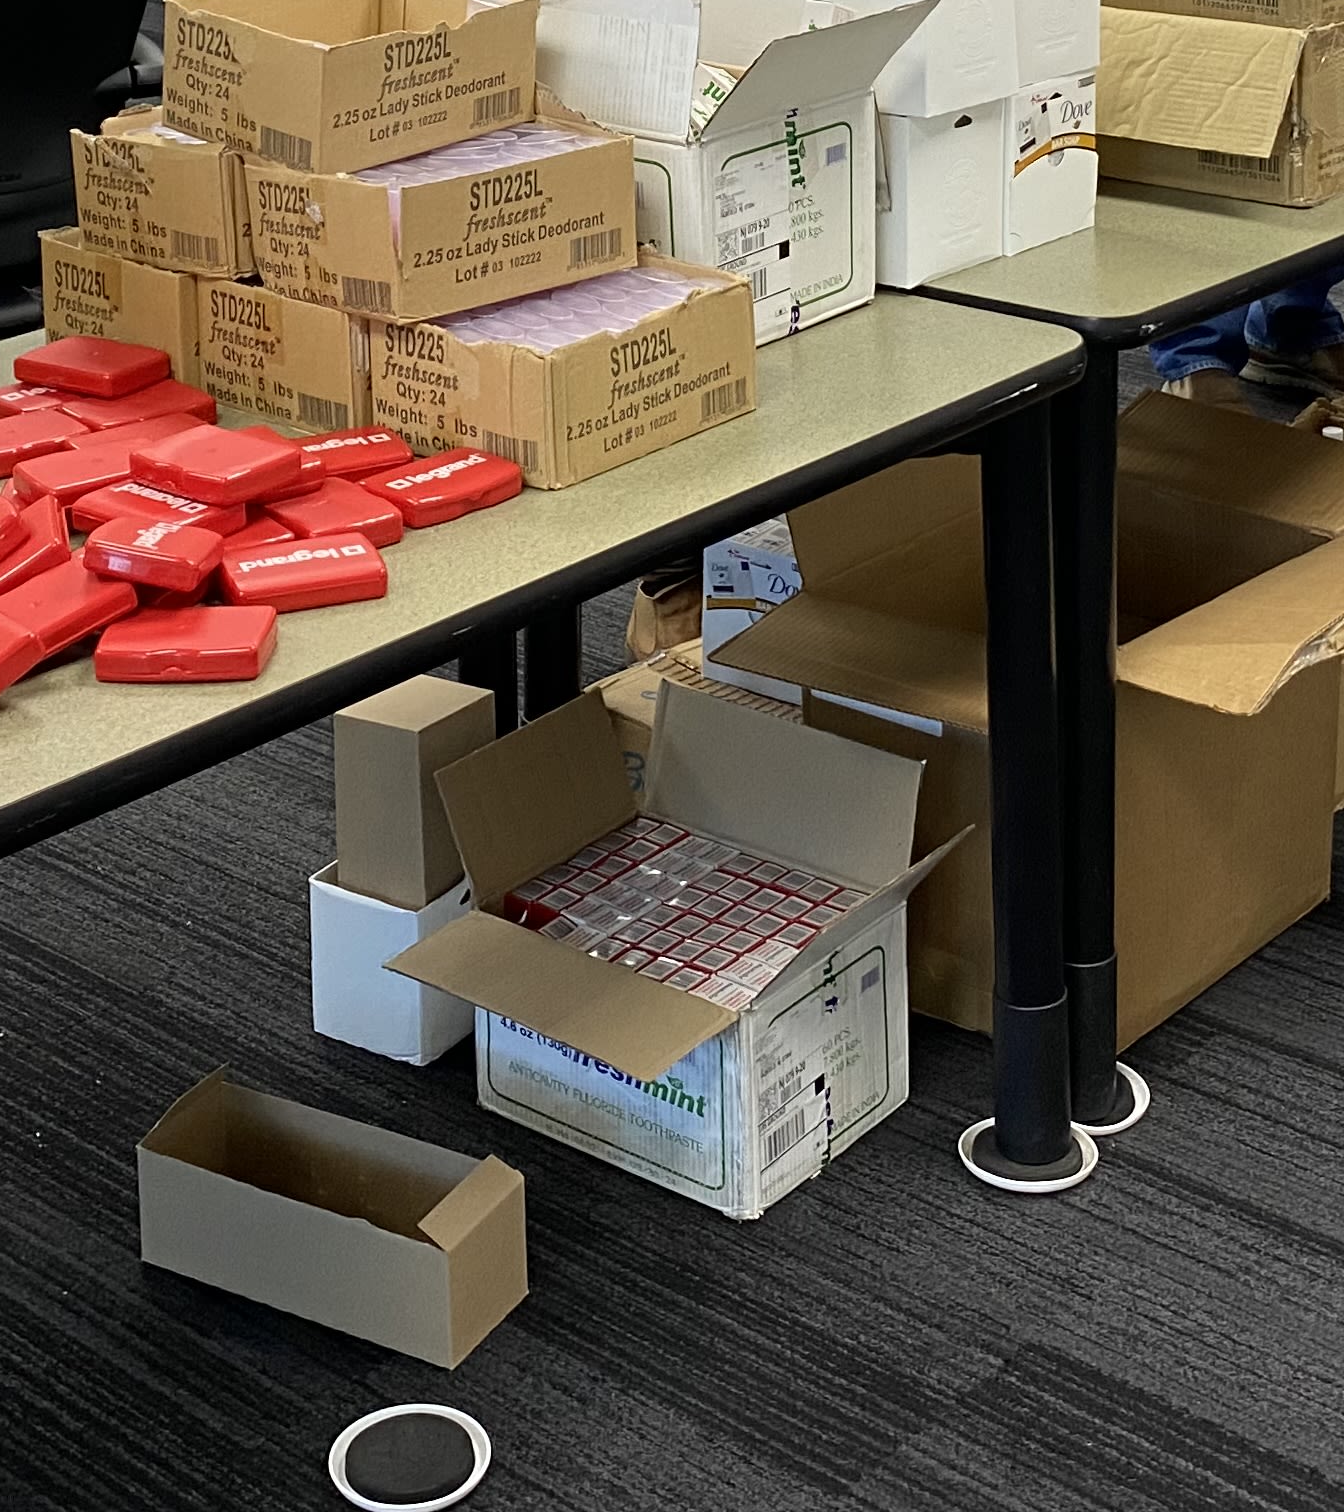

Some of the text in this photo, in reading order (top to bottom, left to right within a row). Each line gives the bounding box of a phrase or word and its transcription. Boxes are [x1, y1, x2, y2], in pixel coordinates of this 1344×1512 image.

[384, 31, 451, 73] STD225L
[186, 74, 230, 101] Qty: 24
[333, 71, 506, 129] 2.25 oz Lady Stick Deodorant
[166, 87, 257, 132] Weight: 5 lbs
[1060, 100, 1092, 123] Dove
[166, 109, 198, 133] Made
[215, 129, 253, 152] China
[369, 126, 390, 142] Lot
[418, 110, 448, 129] 102222
[125, 197, 139, 211] 24
[469, 168, 543, 211] STD225L
[80, 207, 167, 238] Weight: 5 lbs
[84, 230, 113, 248] Made
[130, 239, 165, 259] China
[298, 241, 309, 256] 24
[413, 211, 605, 268] 2.25 oz Lady Stick Deodorant
[55, 260, 110, 300] STD225L
[320, 269, 337, 285] lbs
[455, 266, 477, 283] Lot
[492, 260, 503, 272] 03
[510, 251, 542, 268] 102222
[65, 314, 104, 336] Qty: 24
[211, 289, 271, 332] STD225L
[222, 345, 265, 369] Qty: 24
[610, 327, 677, 378] STD225L
[205, 360, 294, 399] Weight: 5 lbs
[382, 355, 459, 390] freshscent
[207, 383, 238, 404] Made
[256, 397, 292, 419] China
[397, 382, 446, 407] Qty: 24
[567, 361, 731, 442] 2.25 oz Lady Stick Deodorant
[375, 398, 478, 438] Weight: 5 lbs
[302, 436, 368, 452] legra
[432, 436, 456, 452] Chi
[604, 434, 623, 453] Lot
[407, 455, 487, 485] legrand
[238, 548, 340, 573] legrand
[520, 1027, 533, 1039] oz
[508, 1060, 704, 1154] ANTICAVITY FLUORIDE TOOTHPASTE
